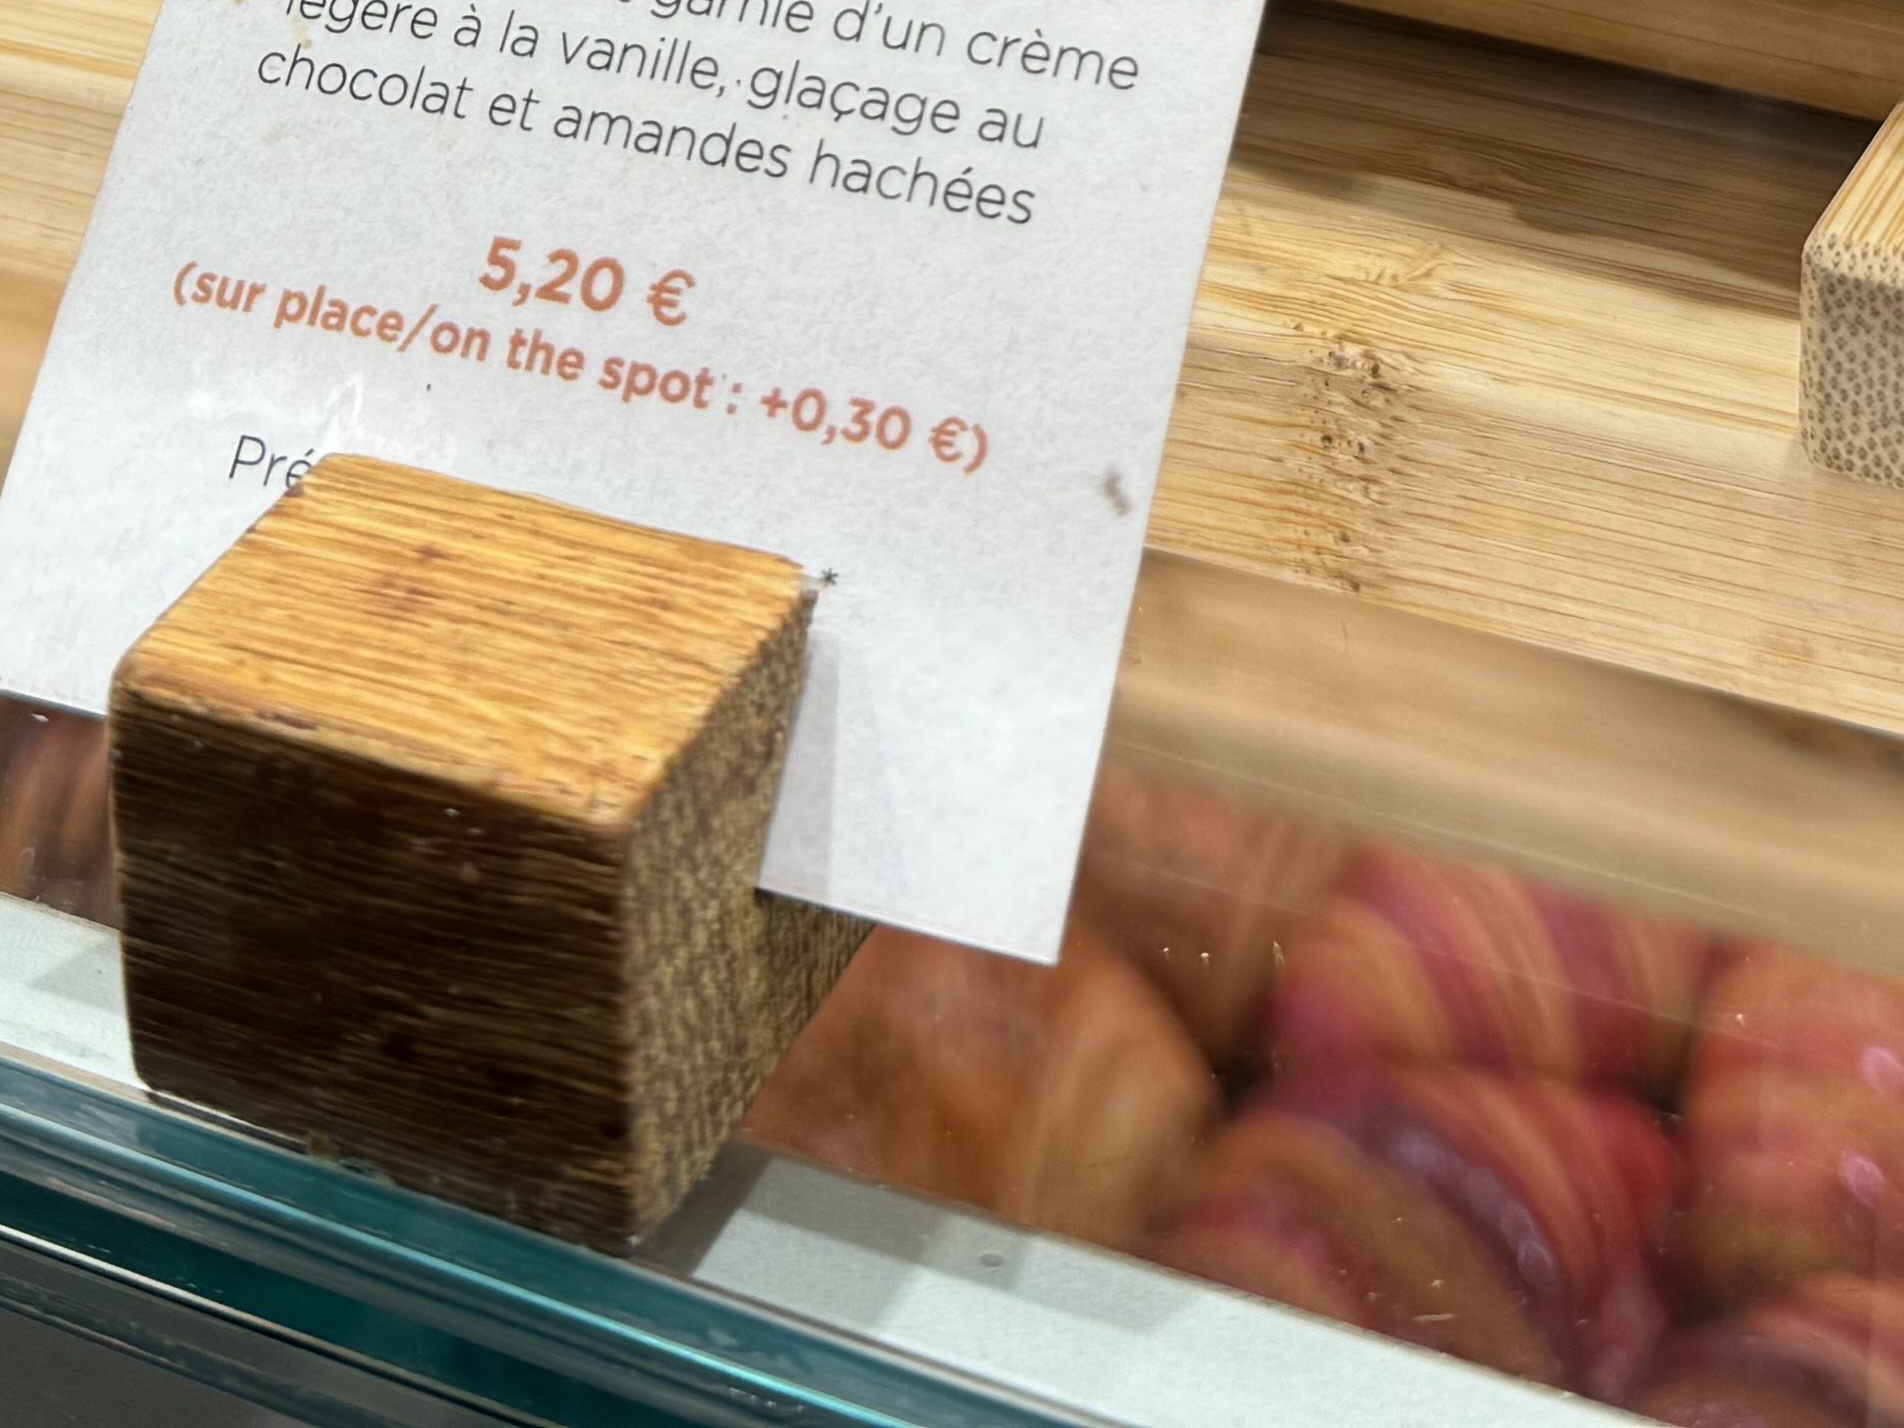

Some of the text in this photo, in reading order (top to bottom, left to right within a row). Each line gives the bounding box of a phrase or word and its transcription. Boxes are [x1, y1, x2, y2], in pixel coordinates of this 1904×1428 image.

[453, 2, 482, 49] à
[498, 8, 540, 59] la
[561, 31, 726, 99] vanille,
[745, 58, 961, 137] glaçage
[976, 107, 1045, 150] au
[966, 27, 1140, 91] crème
[257, 42, 1036, 226] chocolat et amandes hachées
[477, 235, 697, 329] 5,20 €
[172, 260, 267, 315] (sur
[272, 284, 492, 364] place/on
[505, 327, 587, 384] the
[596, 356, 715, 412] spot
[758, 386, 913, 453] +0,30
[927, 415, 990, 477] €)
